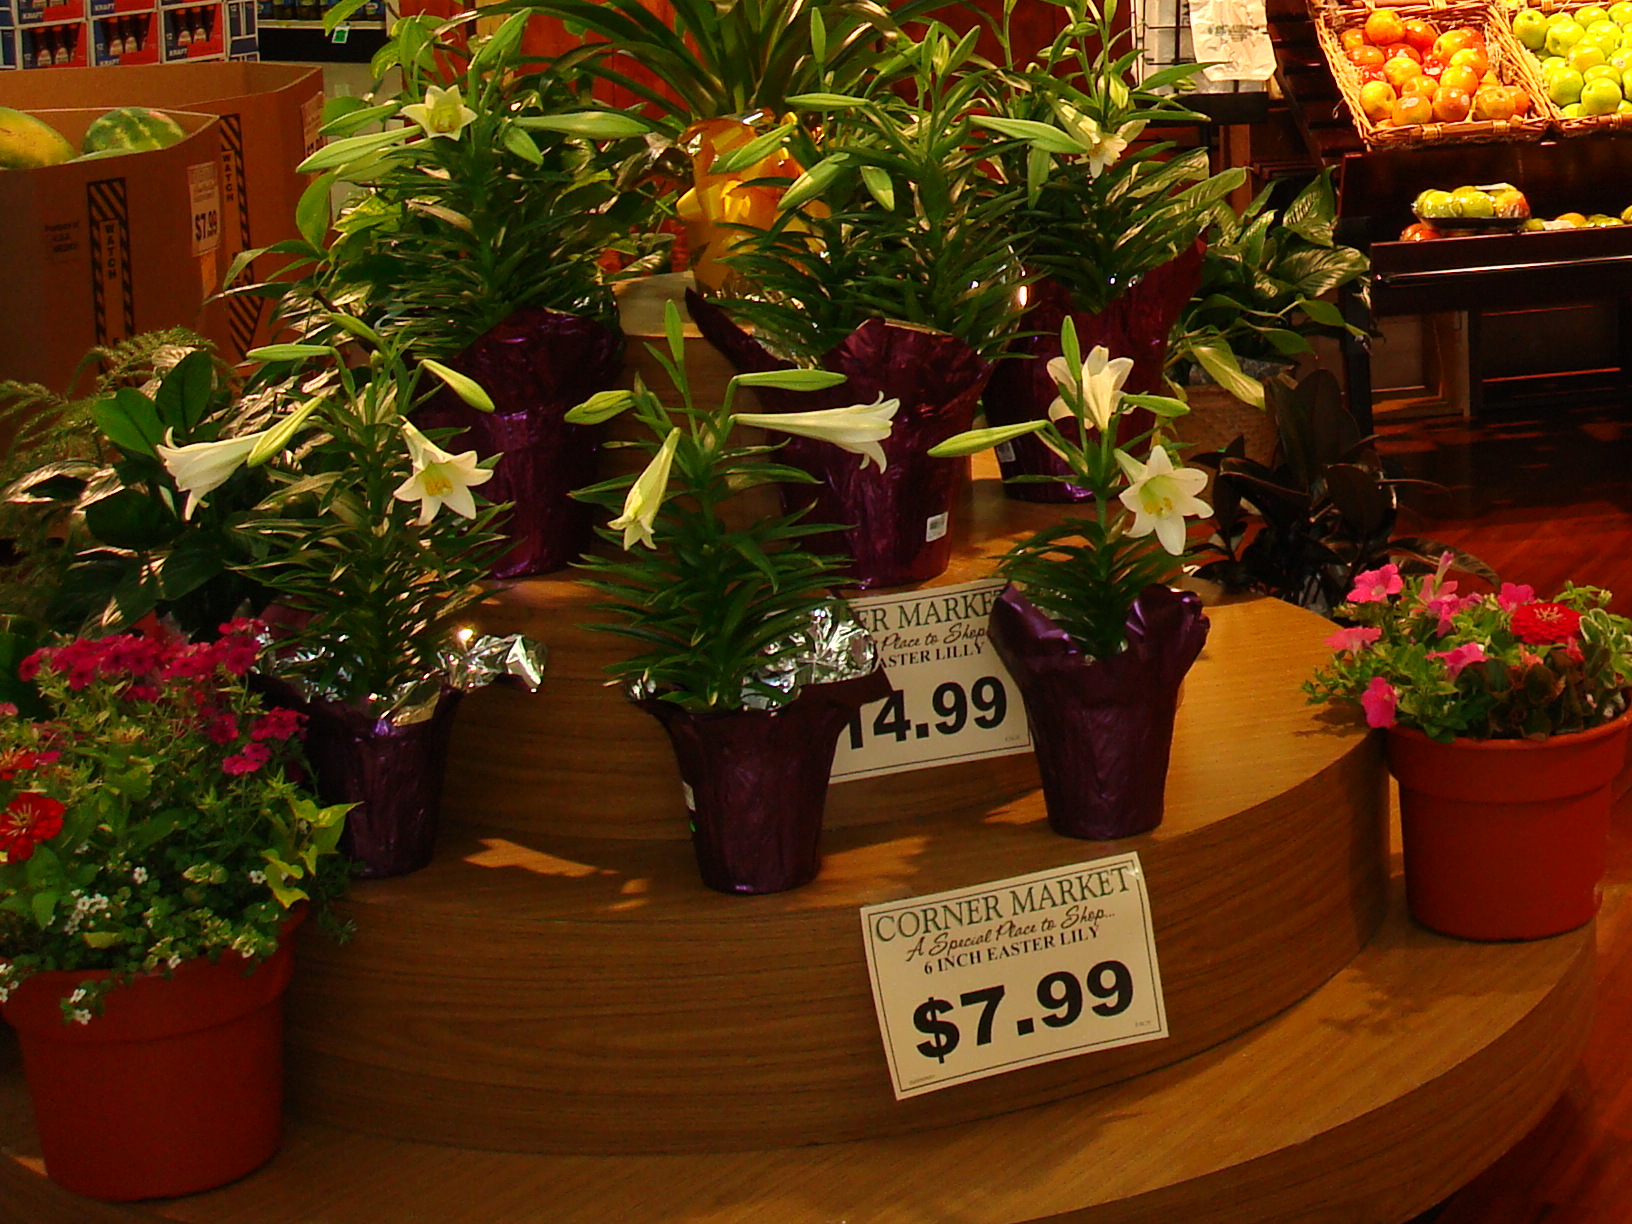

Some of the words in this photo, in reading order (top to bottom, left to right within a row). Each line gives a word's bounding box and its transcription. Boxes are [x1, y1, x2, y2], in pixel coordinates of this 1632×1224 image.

[898, 590, 1002, 629] MARKE
[879, 651, 930, 669] ASTER
[936, 641, 985, 661] LILLY
[881, 632, 921, 651] Place
[924, 634, 939, 647] to
[848, 676, 1008, 750] 14.99
[875, 895, 1007, 943] CORNER
[1010, 865, 1131, 917] MARKET
[906, 936, 926, 962] A
[929, 929, 993, 958] Special
[995, 921, 1037, 942] Place
[1041, 917, 1056, 932] to
[924, 959, 933, 975] 6
[938, 949, 982, 973] INCH
[987, 935, 1056, 961] EASTER
[1060, 924, 1101, 947] LILY
[911, 959, 1135, 1065] $7.99
